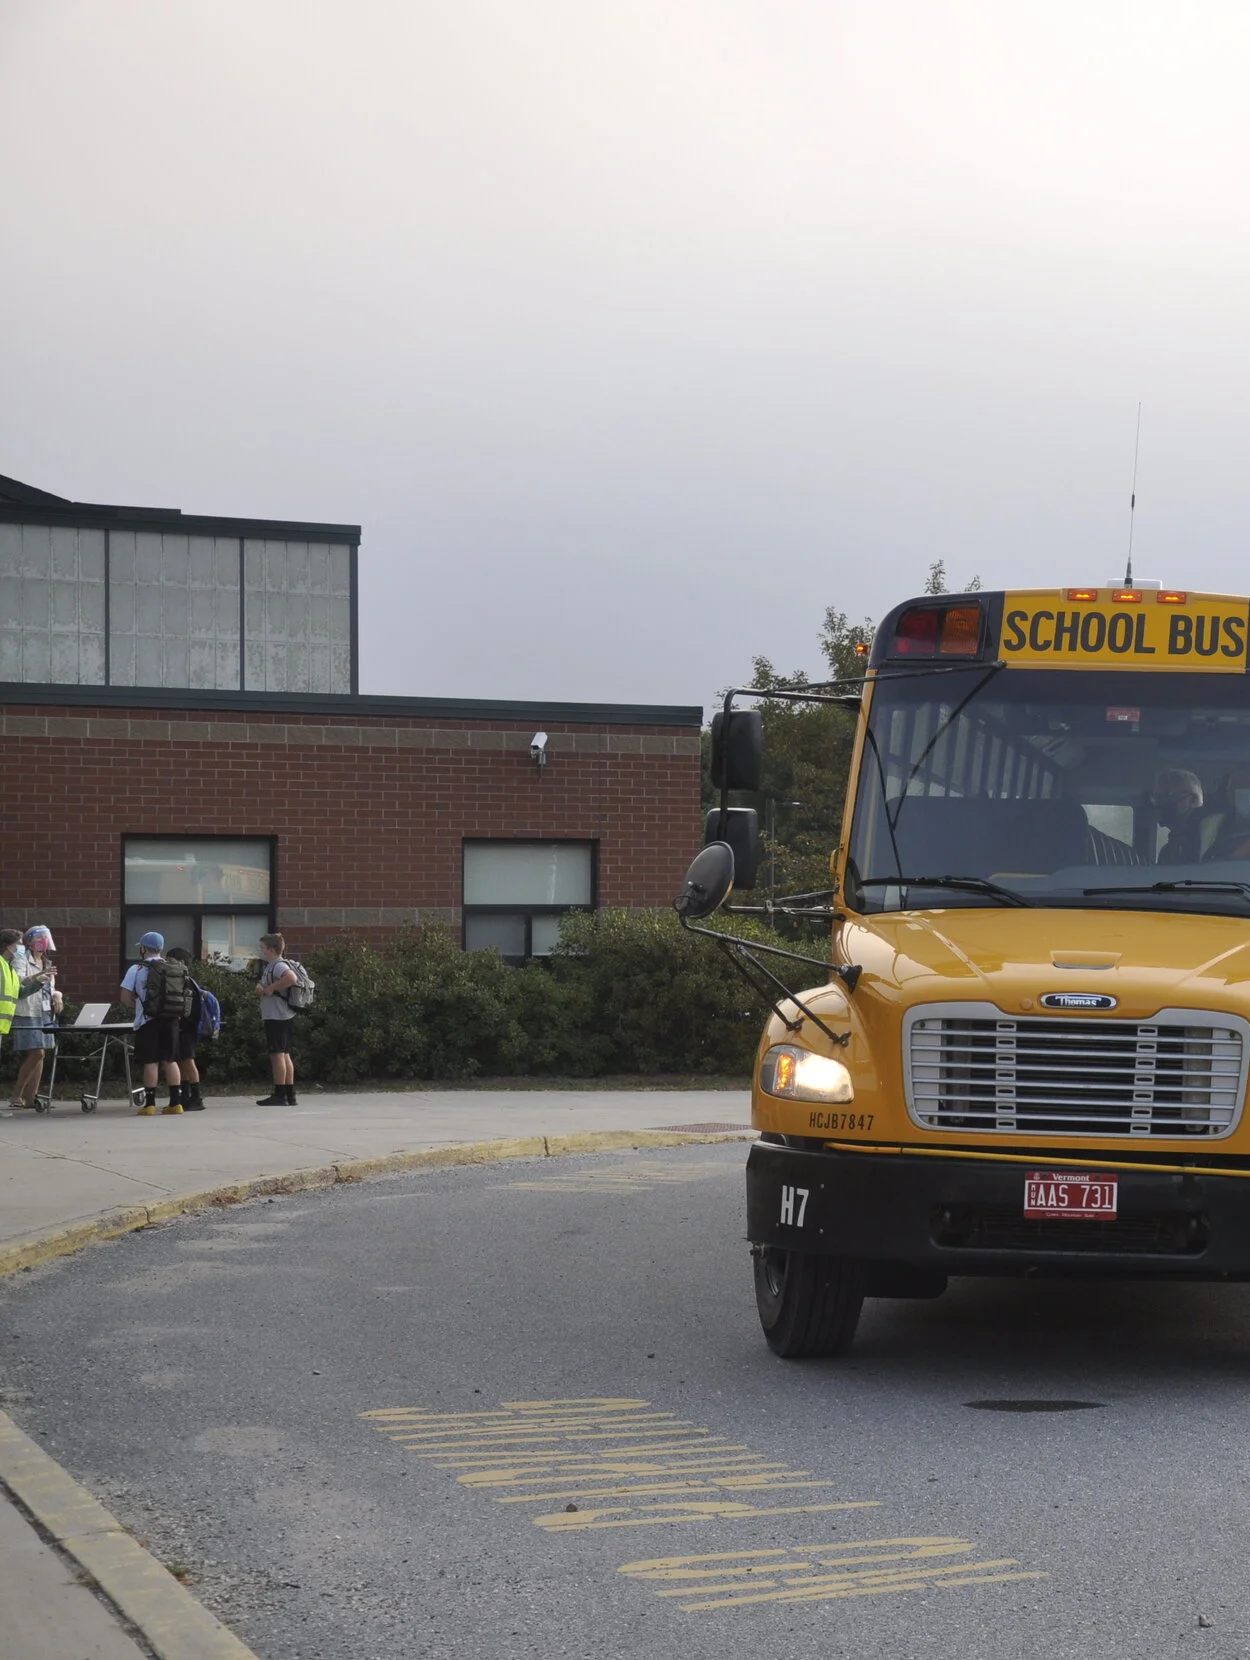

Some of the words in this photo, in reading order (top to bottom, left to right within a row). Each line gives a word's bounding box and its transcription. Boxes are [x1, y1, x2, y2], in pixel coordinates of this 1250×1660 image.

[1003, 610, 1156, 654] SCHOOL
[1168, 614, 1246, 657] BUS
[1055, 995, 1102, 1006] Thomas
[809, 1112, 875, 1131] HCJB7847
[1052, 1173, 1090, 1182] Vermont
[780, 1185, 810, 1228] H7
[1036, 1183, 1069, 1207] AAS
[1080, 1184, 1112, 1208] 731
